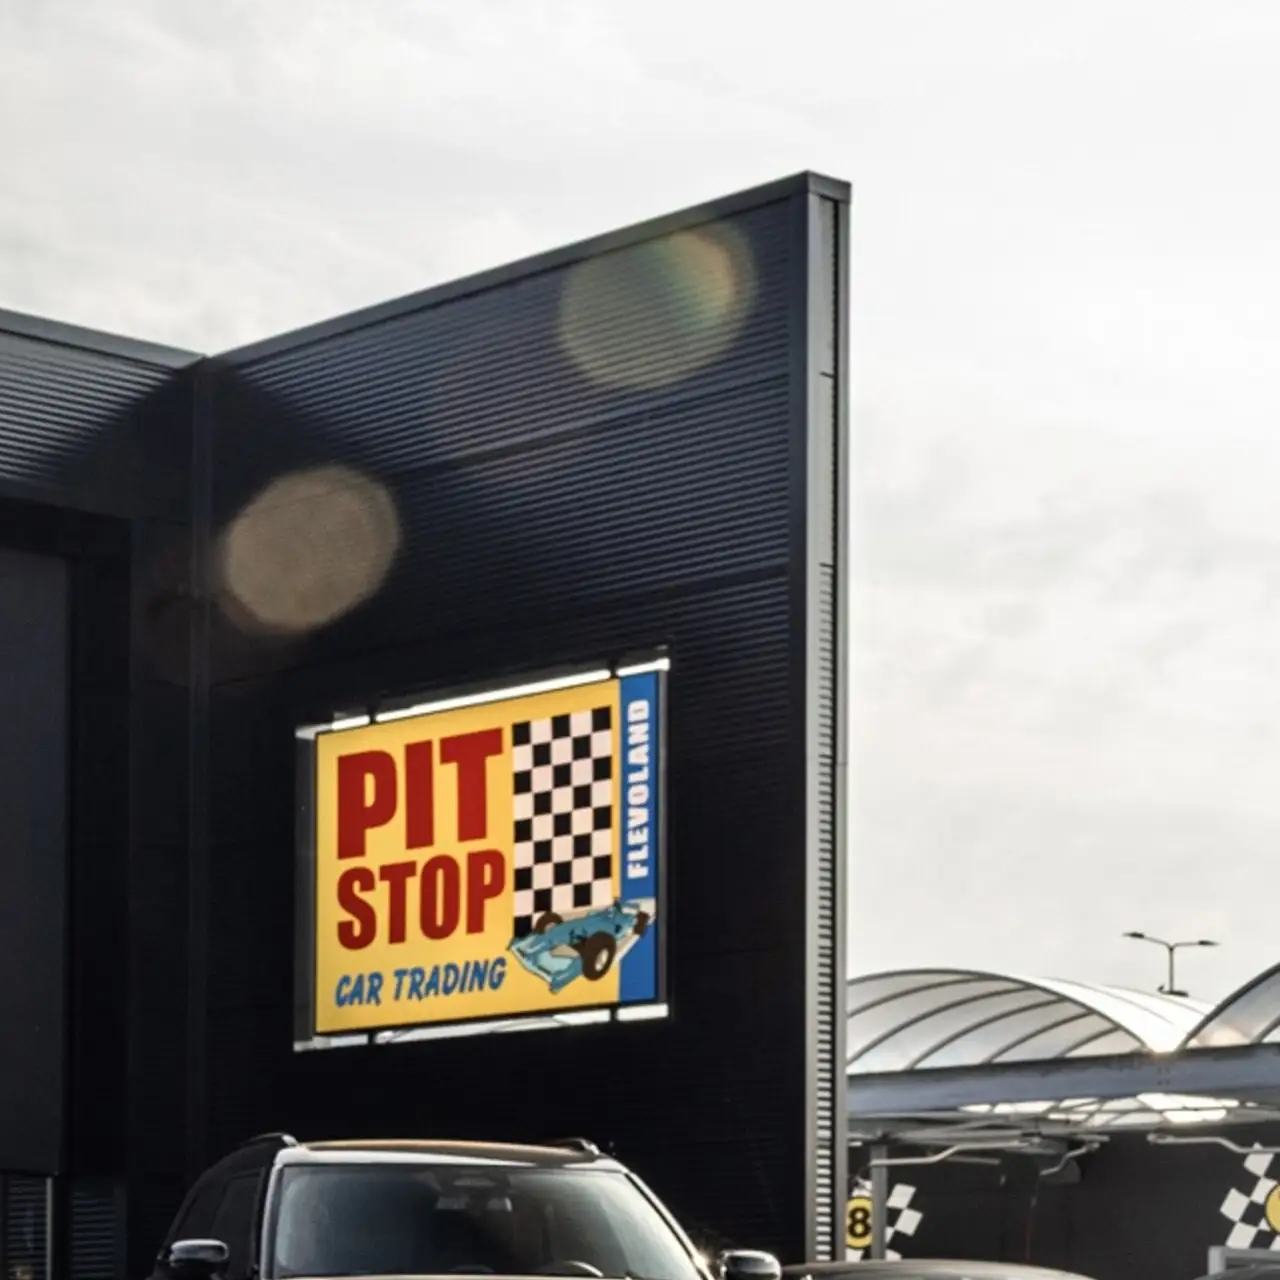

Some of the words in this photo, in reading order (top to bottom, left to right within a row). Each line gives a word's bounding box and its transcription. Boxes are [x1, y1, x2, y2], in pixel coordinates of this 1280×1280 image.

[336, 727, 504, 861] PIT
[626, 698, 651, 881] FLEVOLAND
[336, 848, 507, 952] STOP
[335, 968, 384, 1008] CAR
[393, 957, 508, 1002] TRADING
